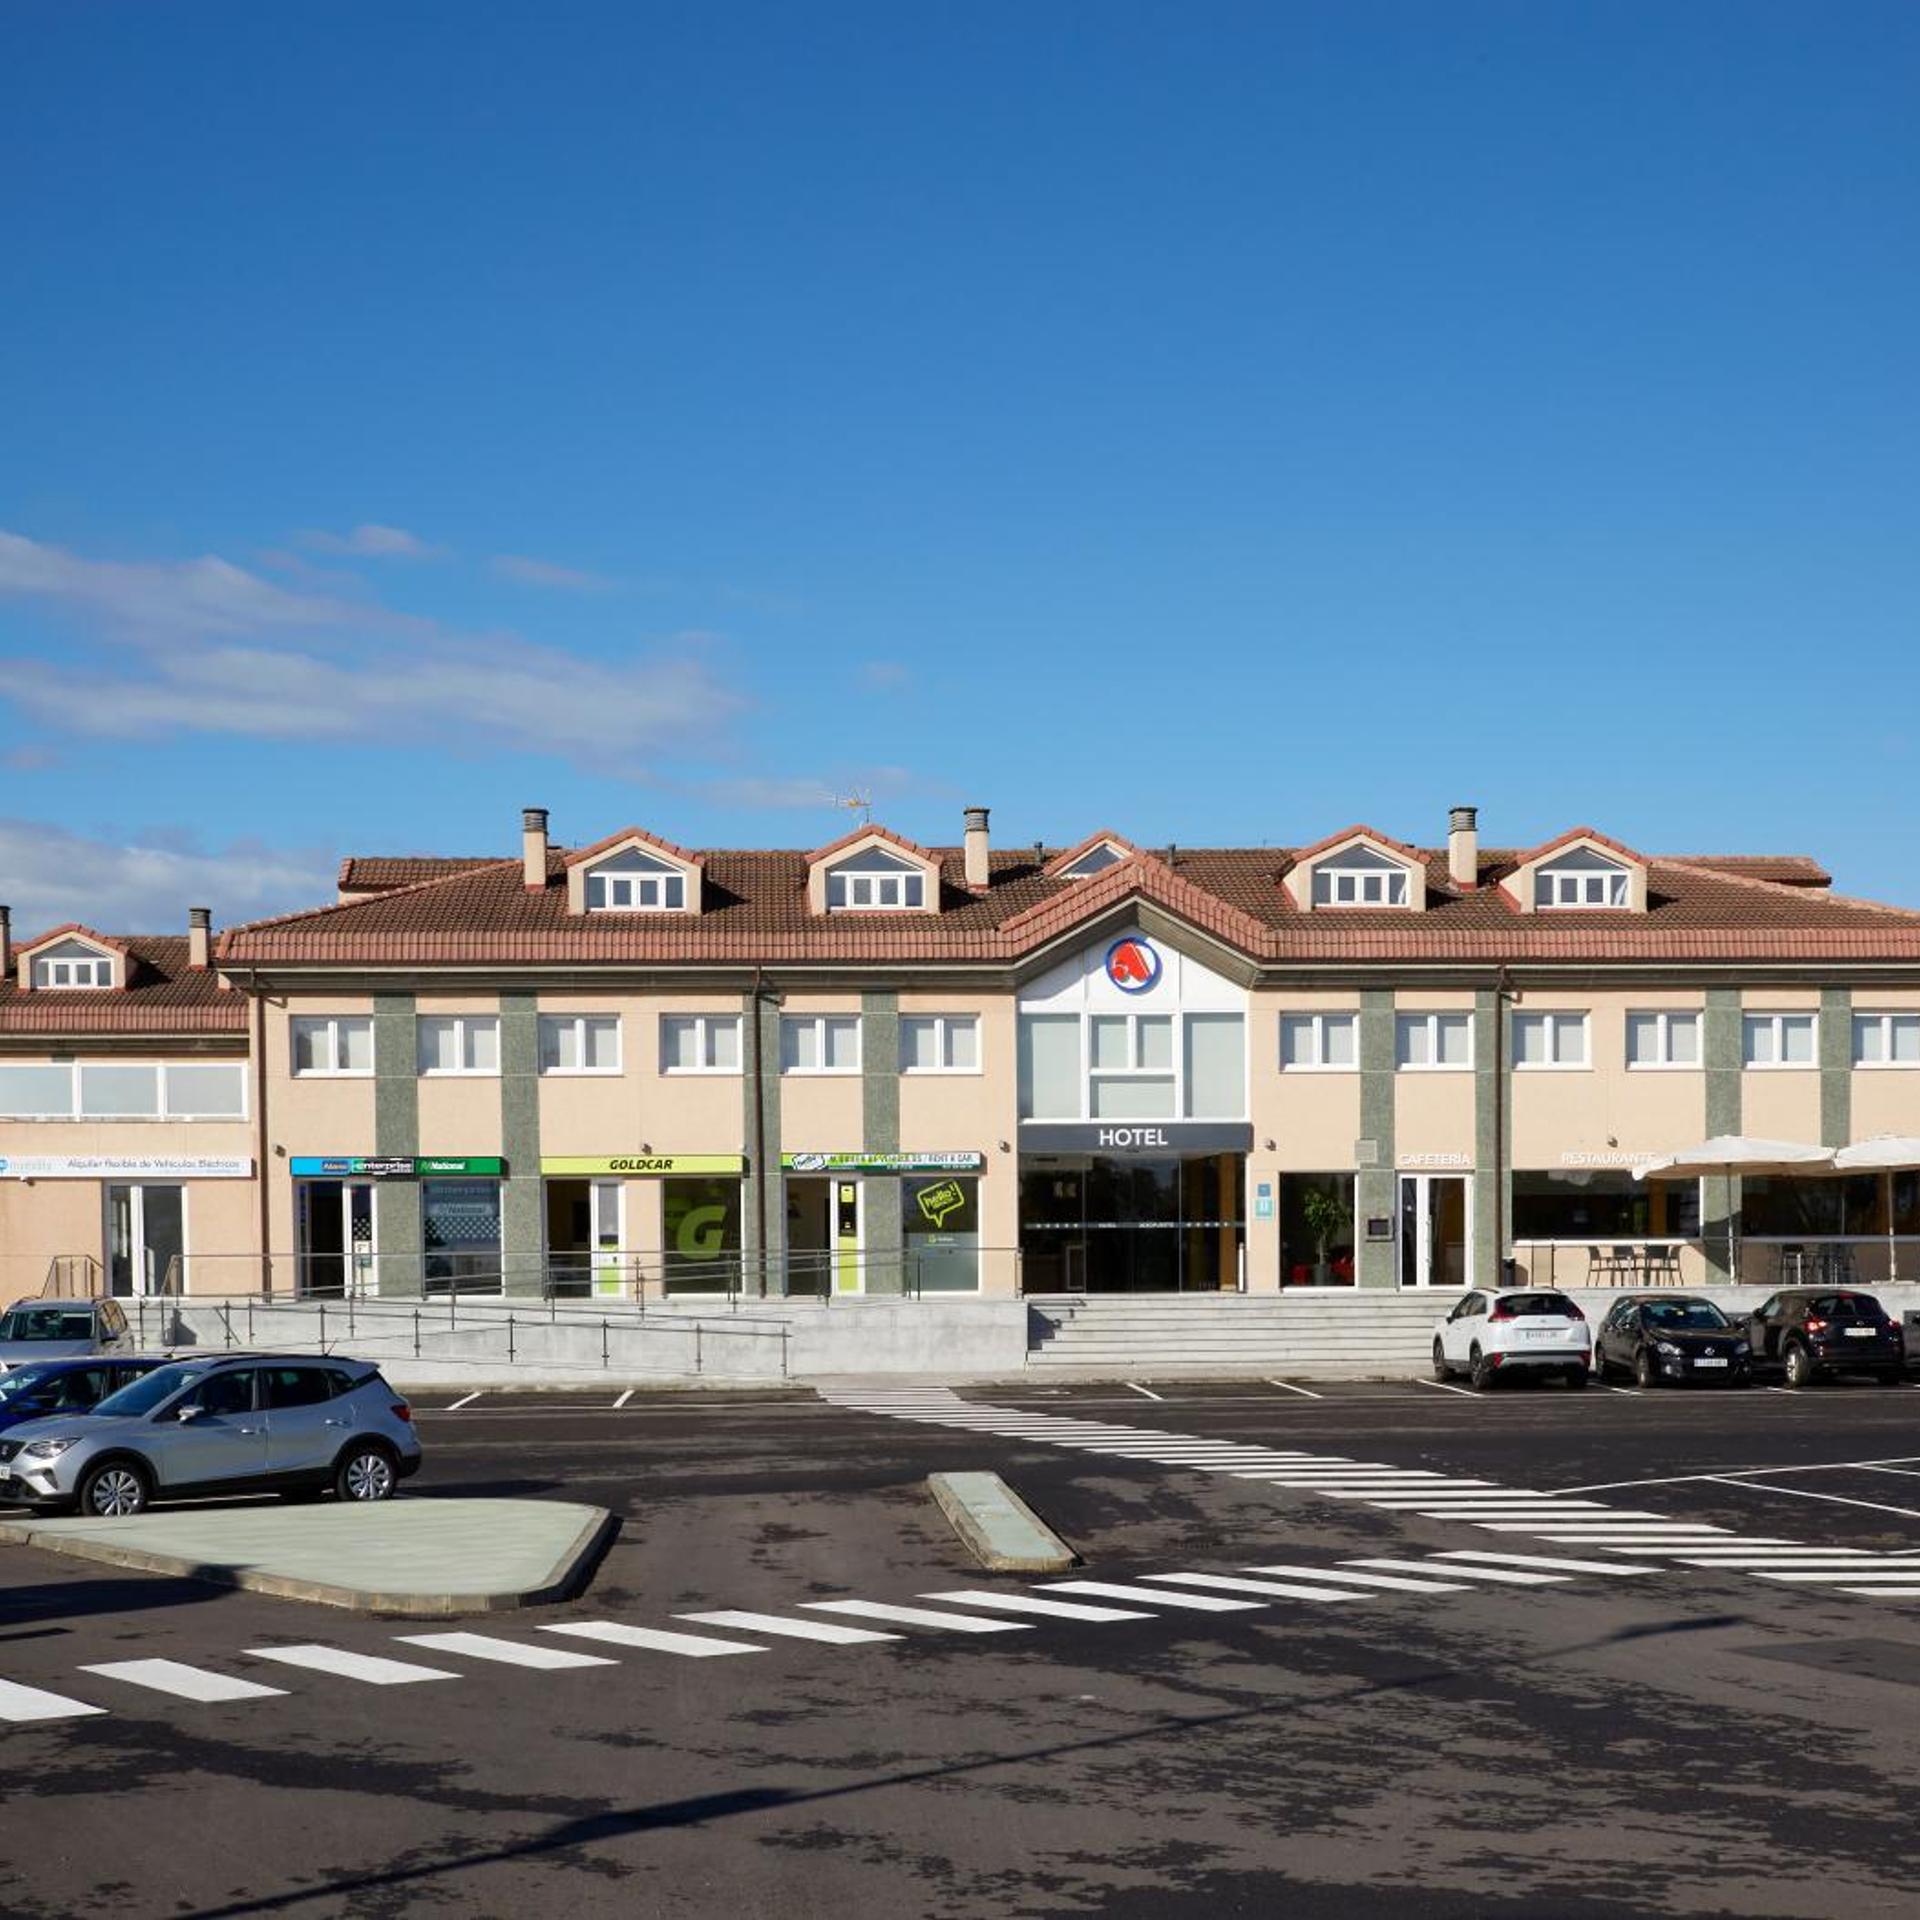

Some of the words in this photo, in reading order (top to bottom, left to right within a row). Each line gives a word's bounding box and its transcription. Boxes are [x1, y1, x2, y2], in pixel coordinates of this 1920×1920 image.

[1099, 1128, 1169, 1146] HOTEL
[140, 1159, 151, 1168] de
[430, 1161, 465, 1170] National
[609, 1159, 673, 1170] GOLDCAR
[677, 1205, 727, 1260] G
